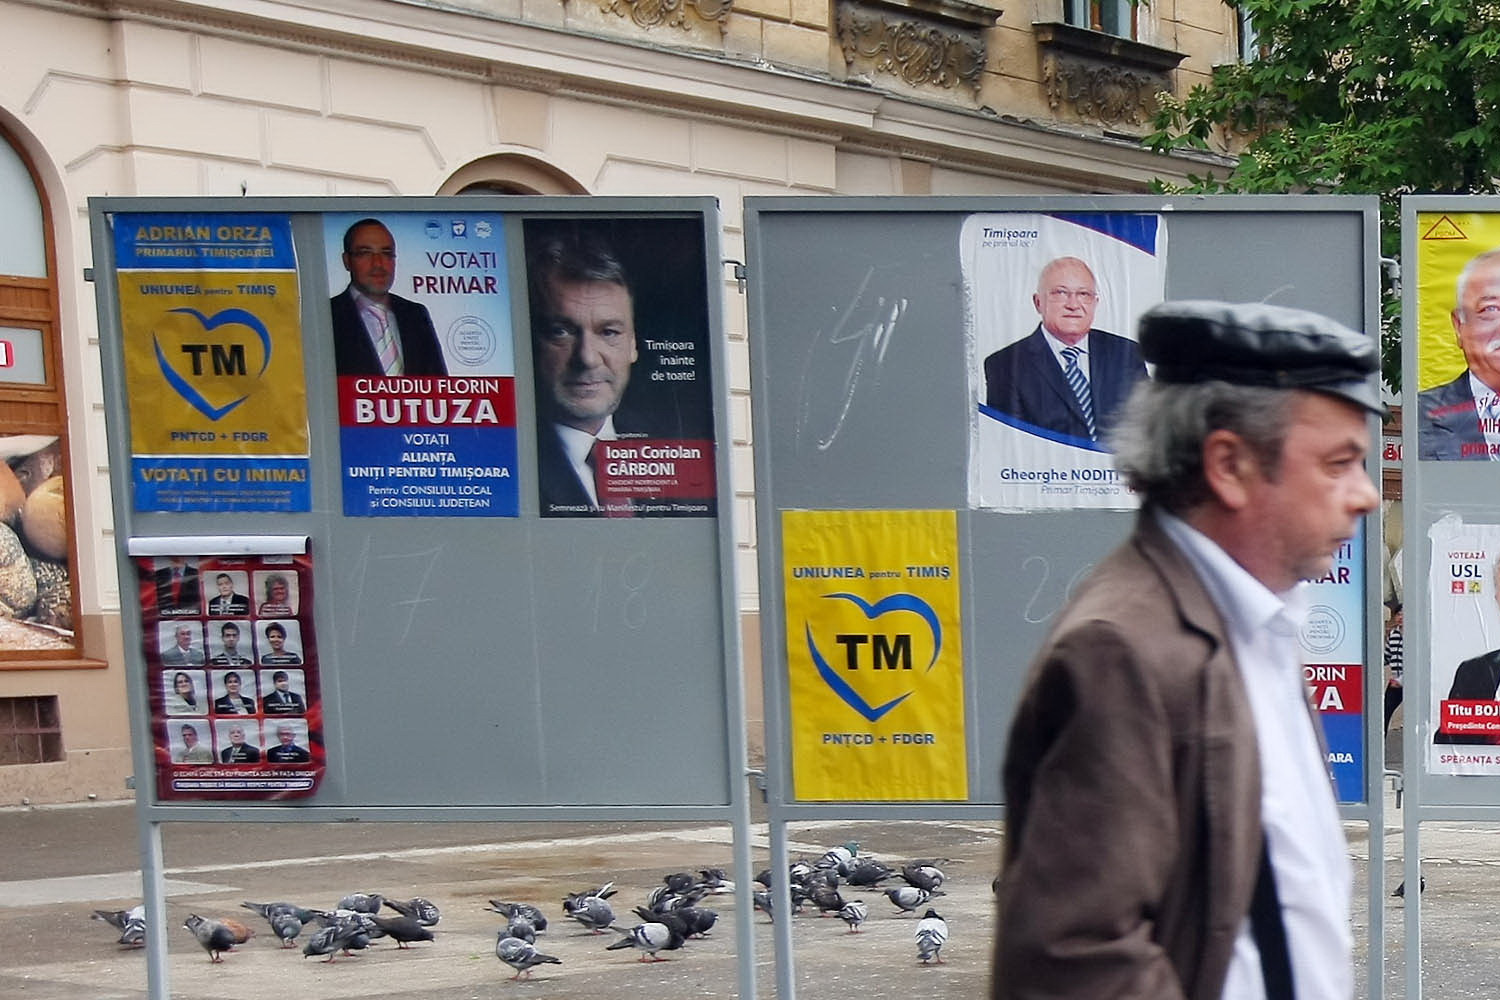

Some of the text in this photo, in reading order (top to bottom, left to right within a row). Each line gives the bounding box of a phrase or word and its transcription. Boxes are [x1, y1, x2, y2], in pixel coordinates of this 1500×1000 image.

[135, 226, 272, 241] ADRIAN ORZA
[983, 228, 1038, 241] Timișoara
[136, 247, 198, 257] PRIMARUL
[426, 251, 497, 273] VOTAȚI
[140, 284, 202, 295] UNIUNEA
[237, 284, 277, 296] TIMIȘ
[412, 275, 499, 295] PRIMAR
[645, 339, 694, 352] Timișoara
[181, 344, 247, 376] TM
[651, 370, 696, 381] de toate!
[355, 378, 500, 394] CLAUDIU FLORIN
[355, 398, 500, 424] BUTUZA
[233, 431, 269, 442] FDGR
[403, 433, 450, 447] VOTAȚI
[401, 452, 457, 465] ALIANȚA
[606, 446, 701, 460] Ioan Coriolan
[349, 466, 511, 481] UNIȚI PENTRU TIMIȘOARA
[607, 460, 675, 476] GÂRBONI
[141, 468, 307, 486] VOTAȚI CU INIMA!
[1000, 468, 1068, 483] Gheorghe
[368, 485, 493, 496] Pentru CONSILIUL LOCAL
[1041, 484, 1120, 497] Primar Timișoara
[381, 498, 436, 508] CONSILIUL
[1448, 550, 1486, 559] VOTEAZĂ
[793, 566, 951, 581] UNIUNEA pentru TIMIȘ
[1451, 564, 1482, 578] USL
[836, 634, 912, 671] TM
[1448, 704, 1473, 716] Titu
[1447, 721, 1486, 732] Președinte
[892, 733, 935, 745] FDGR
[1440, 754, 1493, 766] SPERANȚA
